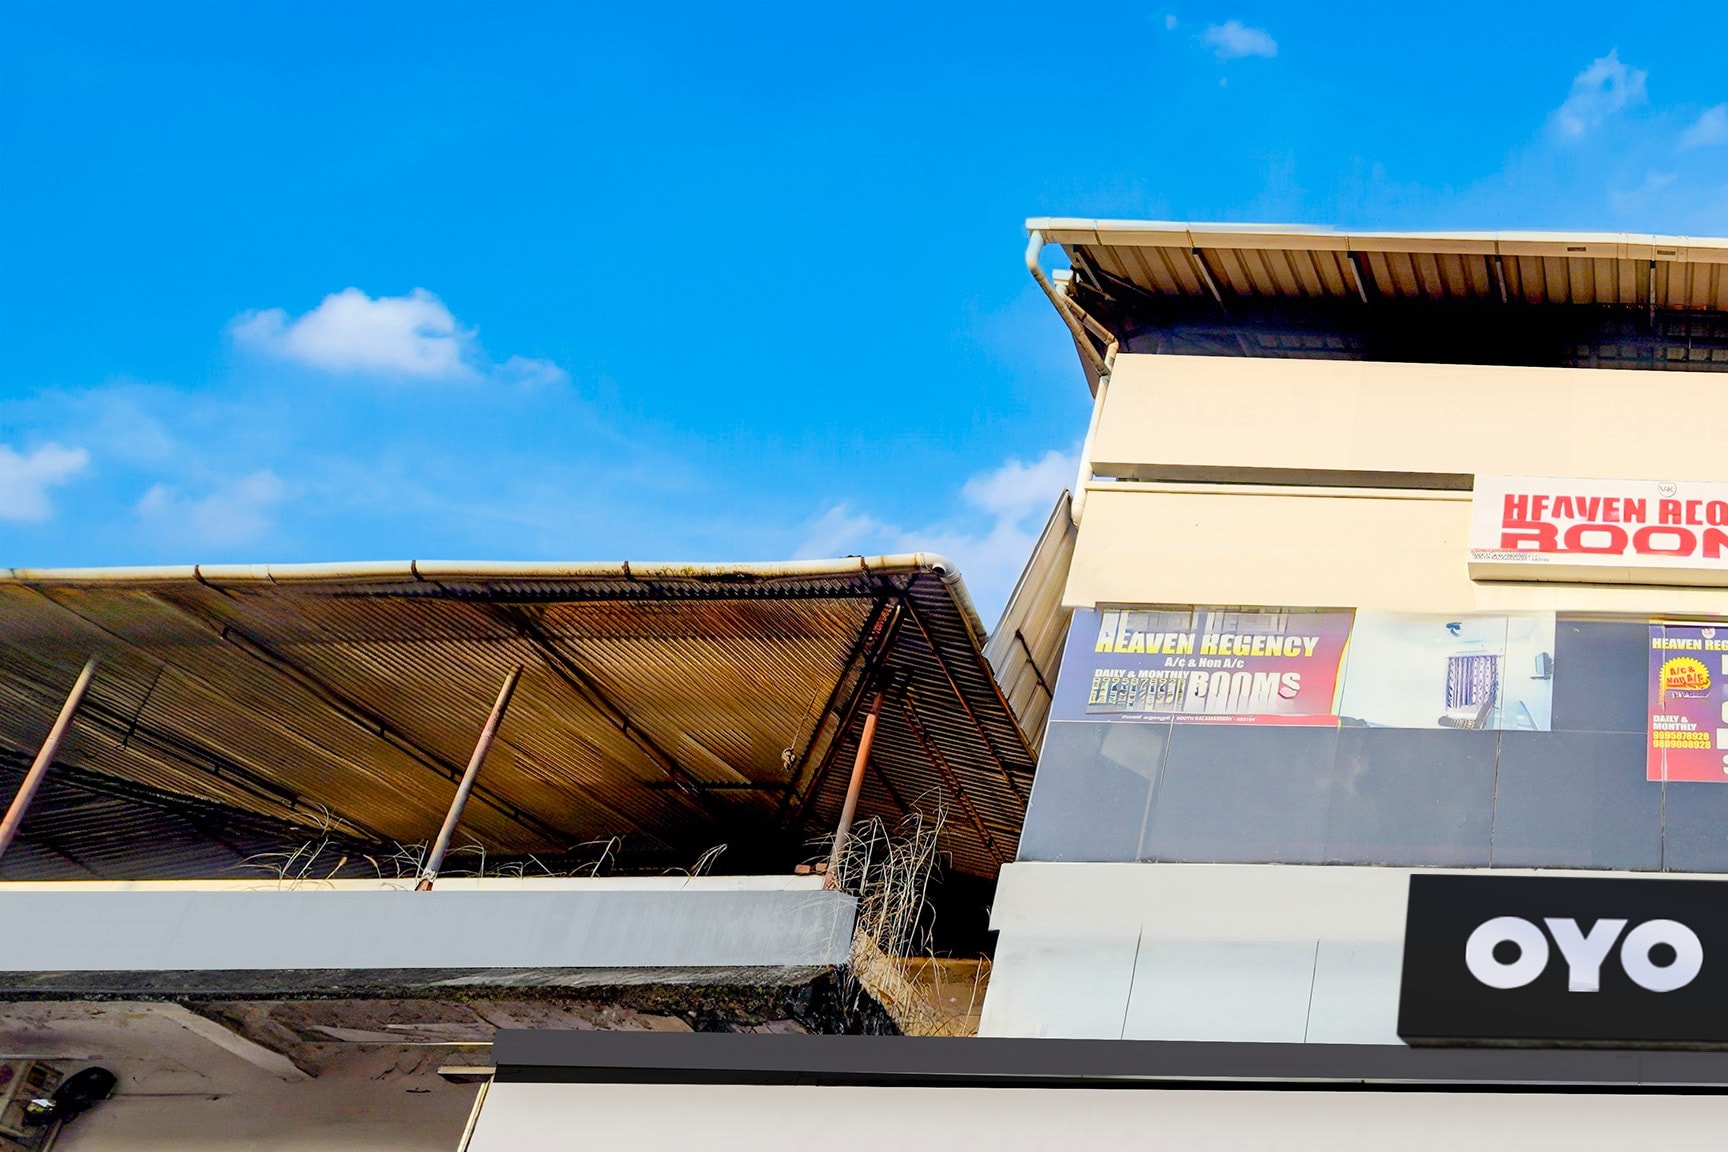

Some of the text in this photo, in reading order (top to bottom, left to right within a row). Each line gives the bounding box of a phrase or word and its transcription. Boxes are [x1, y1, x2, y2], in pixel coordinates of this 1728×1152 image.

[1504, 494, 1648, 523] HEAVEN
[1095, 631, 1320, 657] HEAVEN REGENCY
[1652, 638, 1702, 650] HEAVEN
[1187, 658, 1197, 668] &
[1198, 658, 1222, 668] Non
[1223, 658, 1245, 669] A/c
[1095, 669, 1126, 678] DAILY
[1137, 670, 1190, 679] MONTHLY
[1653, 715, 1680, 723] DAILY
[1653, 723, 1697, 731] MONTHLY
[1465, 915, 1704, 993] OYO
